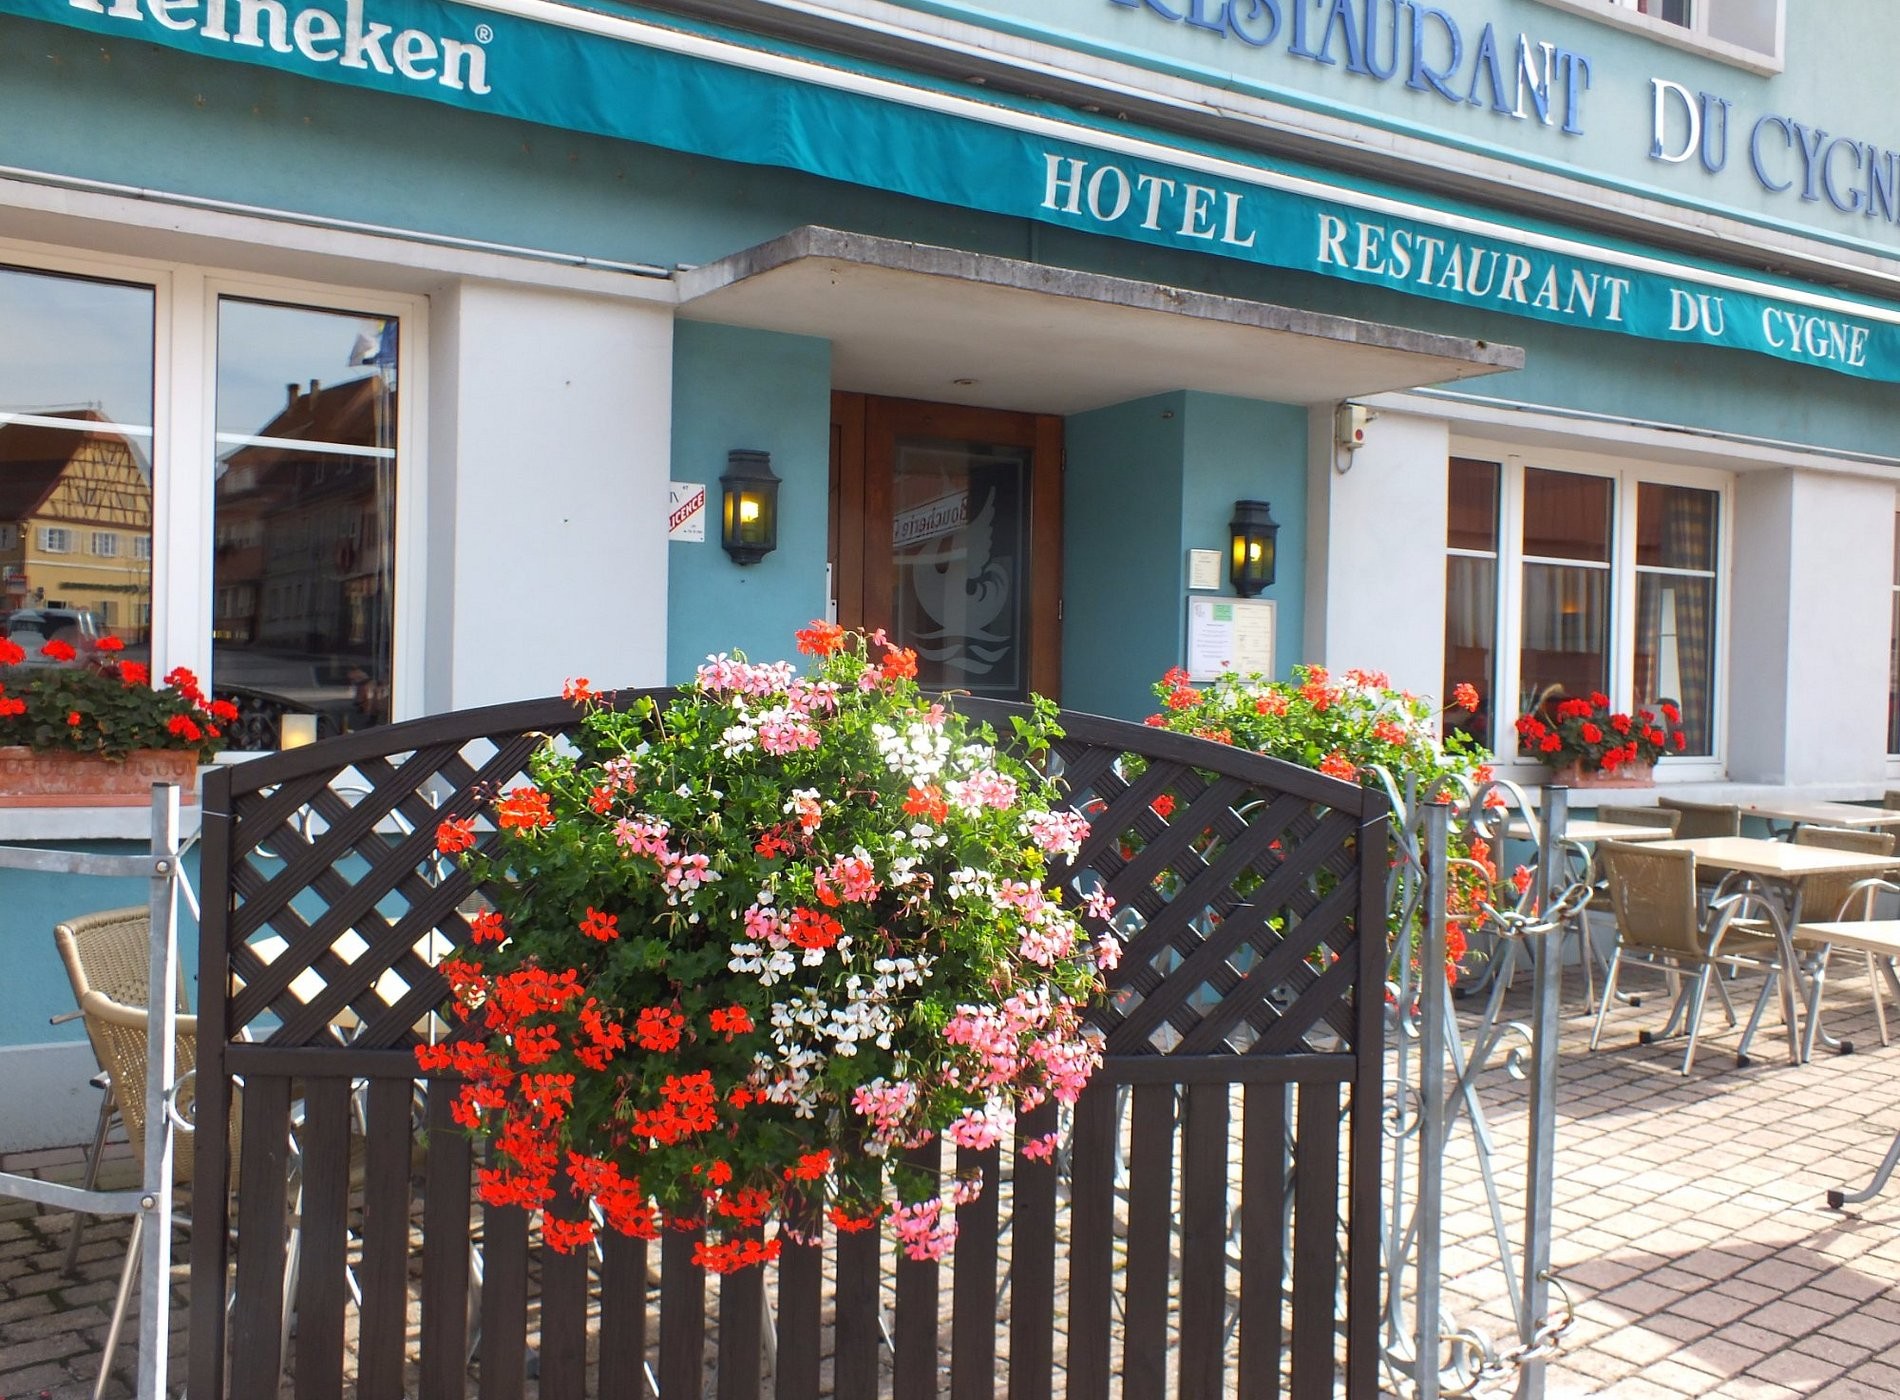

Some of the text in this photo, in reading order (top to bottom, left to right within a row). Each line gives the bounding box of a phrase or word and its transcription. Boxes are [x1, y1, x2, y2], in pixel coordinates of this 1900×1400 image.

[69, 0, 491, 95] eineken
[1109, 0, 1900, 226] STAURANT DU CYGN
[1040, 152, 1870, 368] HOTEL RESTAURANT DU CYGNE
[669, 491, 704, 529] ICENCE
